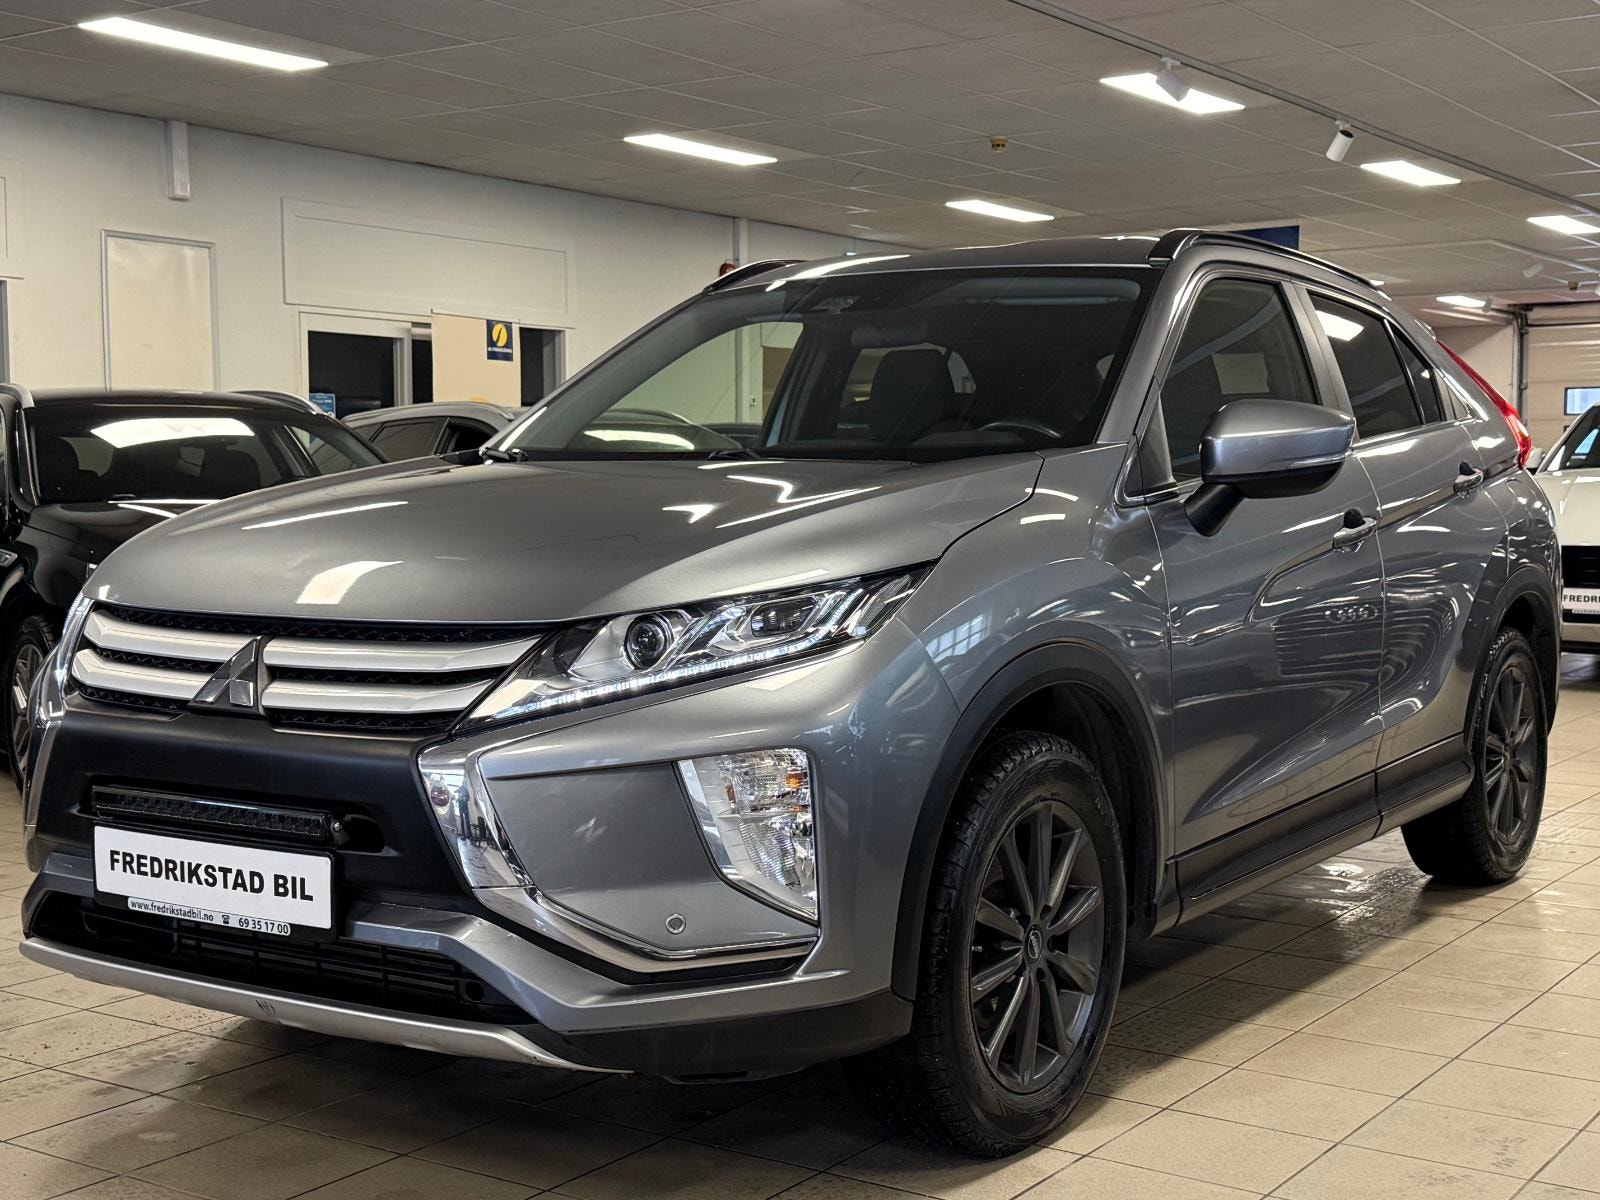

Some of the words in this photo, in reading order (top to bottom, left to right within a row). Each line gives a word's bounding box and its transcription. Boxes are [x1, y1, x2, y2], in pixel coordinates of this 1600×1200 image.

[109, 849, 265, 894] FREDRIKSTAD
[273, 873, 314, 902] BIL
[130, 900, 214, 922] www.fredrikstadbil.no
[238, 917, 250, 928] 69
[251, 919, 262, 930] 35
[264, 921, 275, 932] 17
[277, 923, 289, 934] 00
